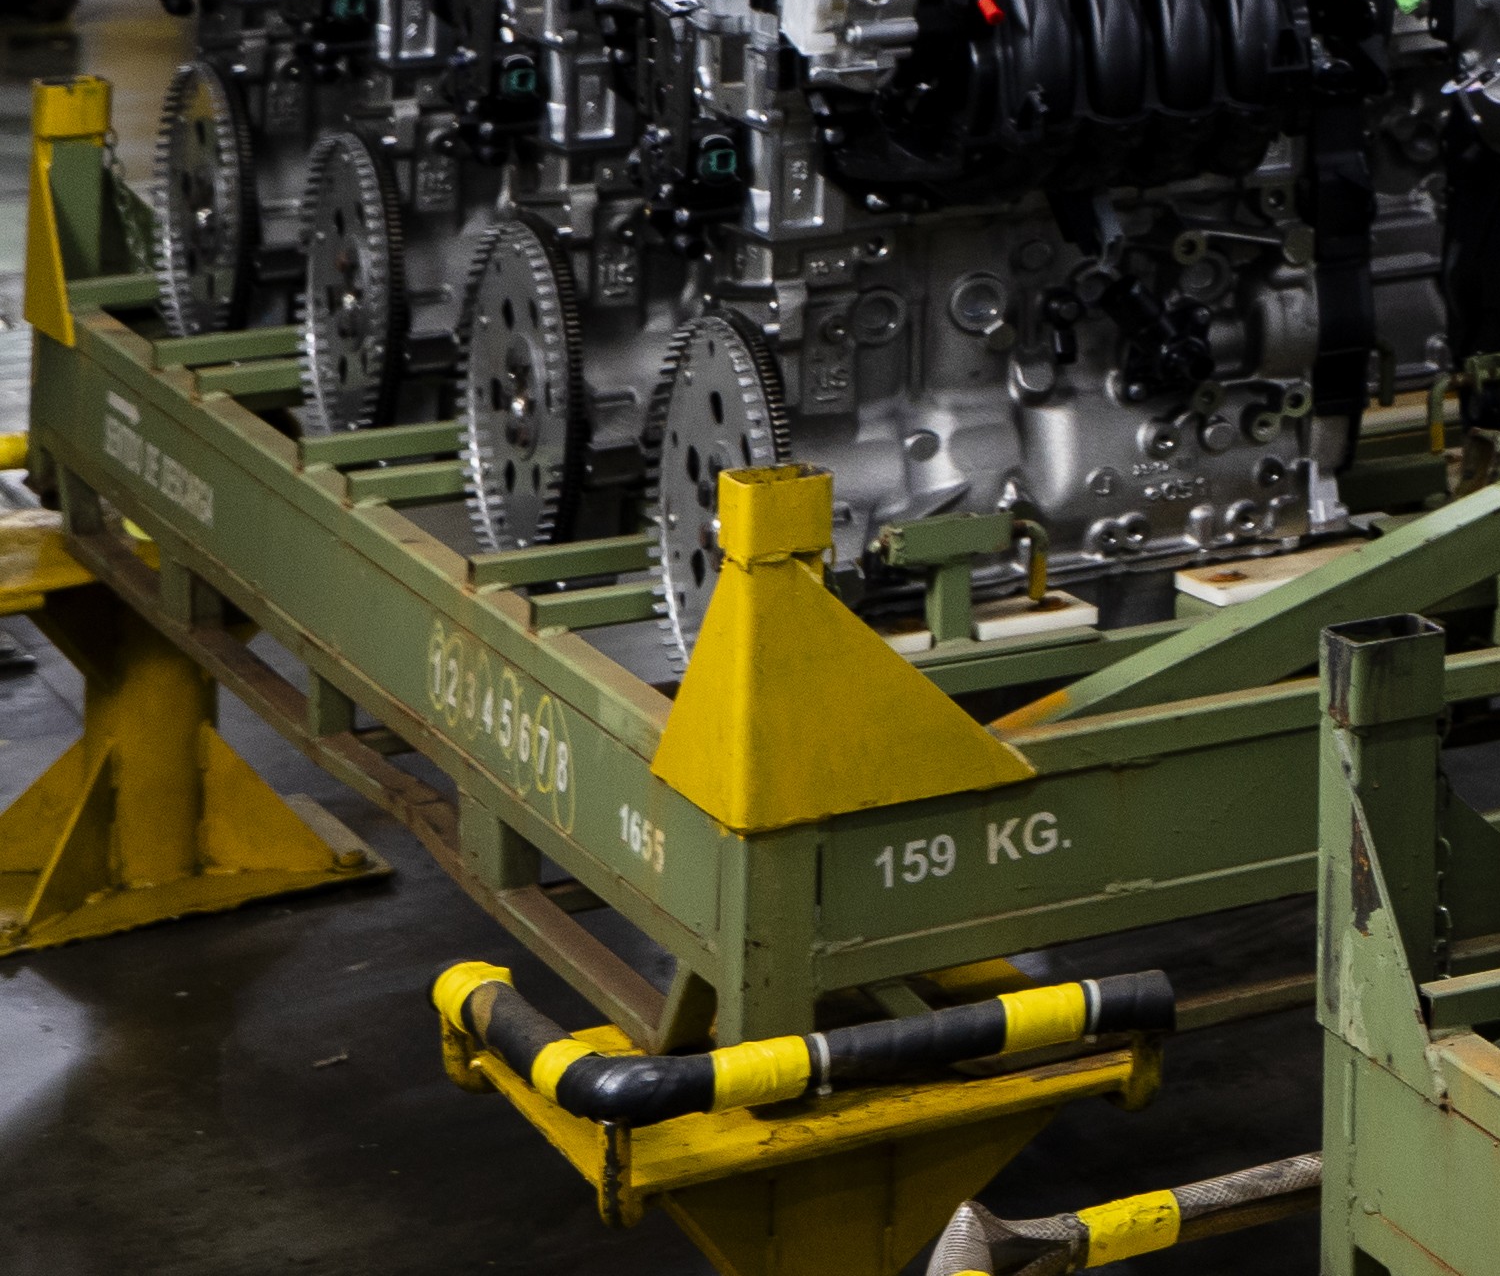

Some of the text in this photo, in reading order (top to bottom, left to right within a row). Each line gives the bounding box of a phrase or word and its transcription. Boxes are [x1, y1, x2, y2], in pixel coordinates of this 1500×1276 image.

[618, 803, 667, 874] 1655
[874, 811, 1073, 888] 159 KG.
